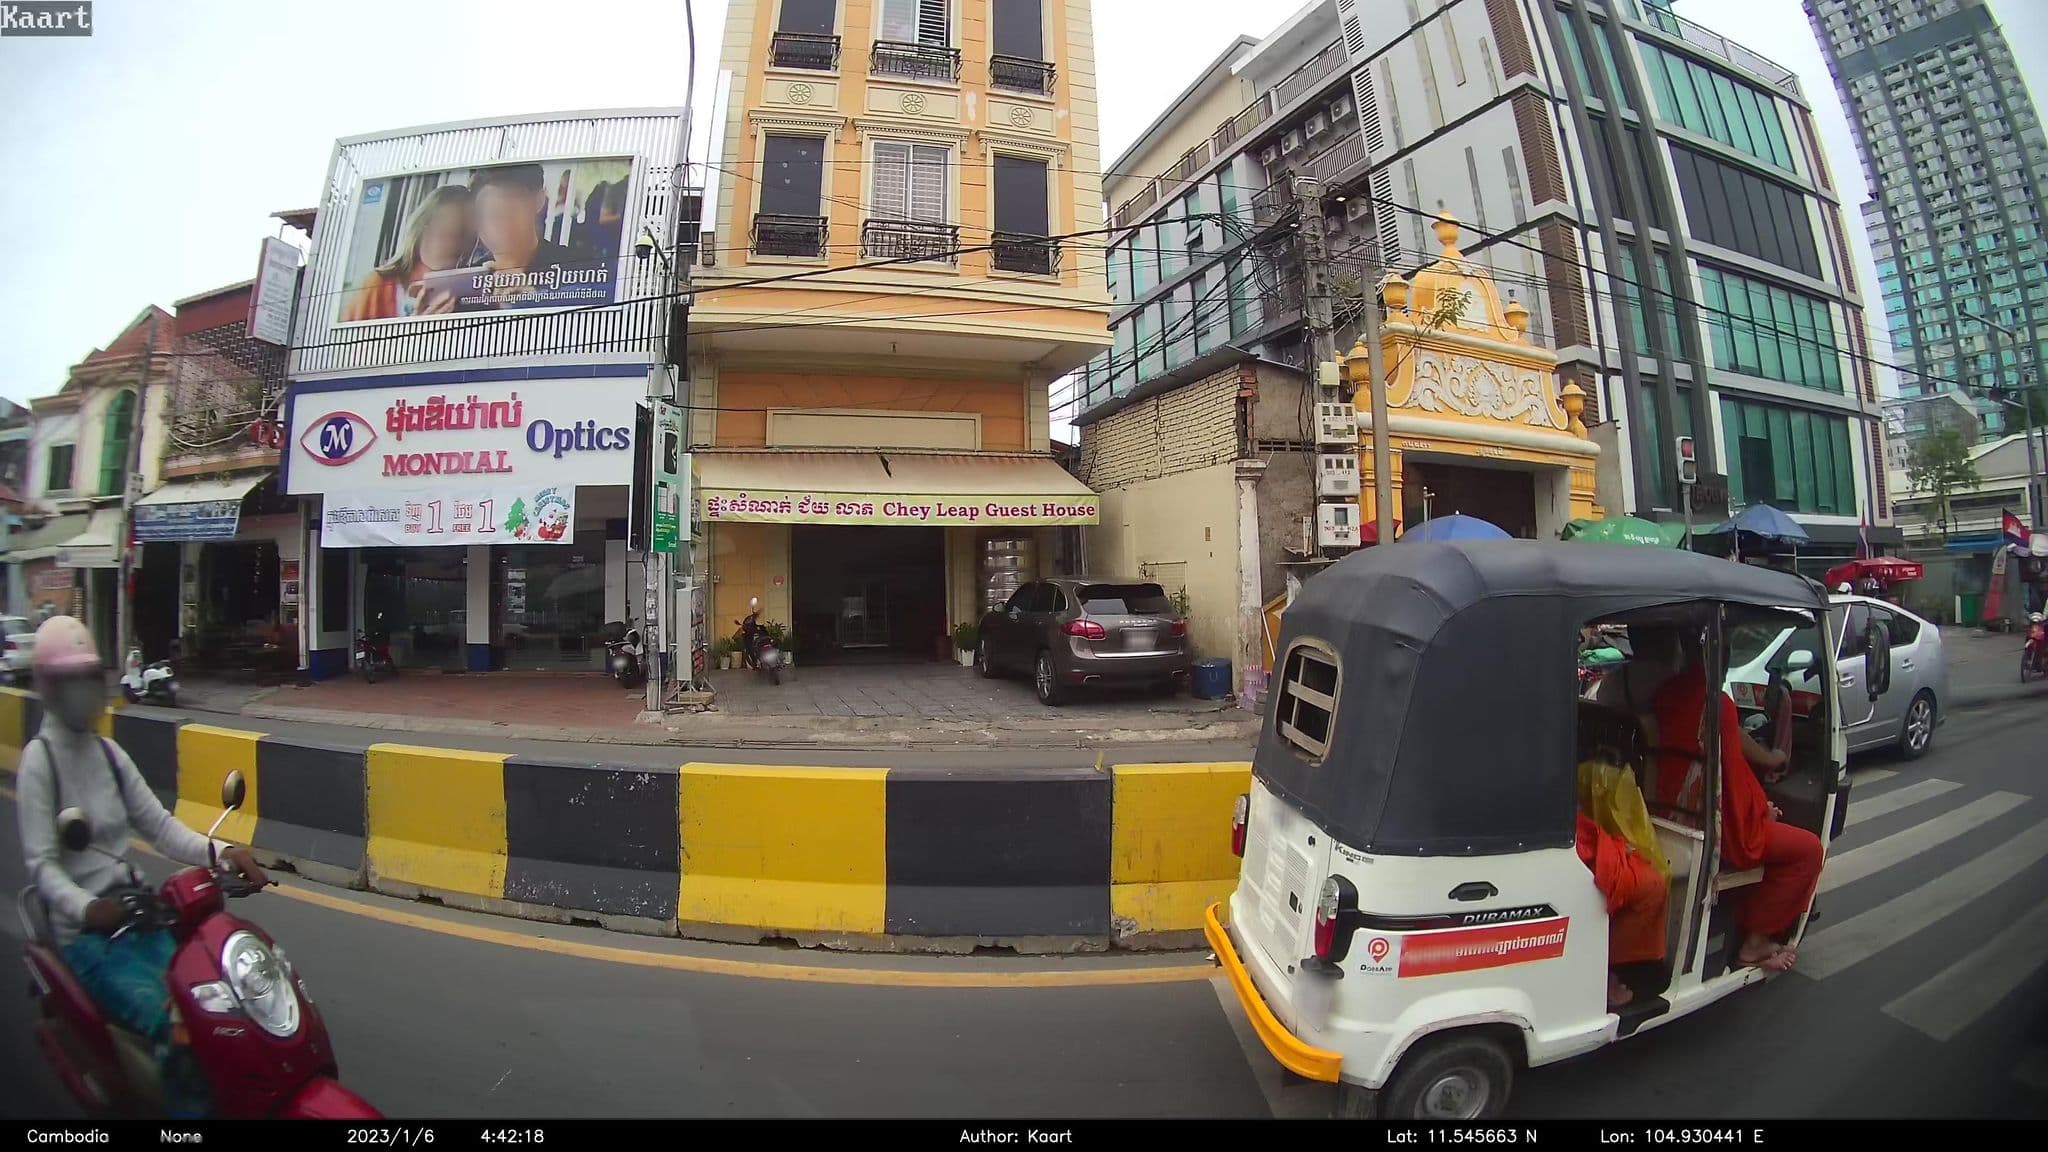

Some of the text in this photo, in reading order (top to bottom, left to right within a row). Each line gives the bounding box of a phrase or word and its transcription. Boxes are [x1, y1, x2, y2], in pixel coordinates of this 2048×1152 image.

[526, 418, 631, 459] Optics
[381, 450, 513, 477] MONDIAL
[427, 499, 444, 534] 1
[477, 499, 497, 533] 1
[798, 494, 830, 515] ជ័យ
[883, 501, 930, 521] Chey
[936, 502, 980, 521] Leap
[985, 502, 1039, 518] Guest
[1042, 502, 1096, 517] House
[452, 523, 472, 533] FREE
[1462, 907, 1544, 925] DURAMAX
